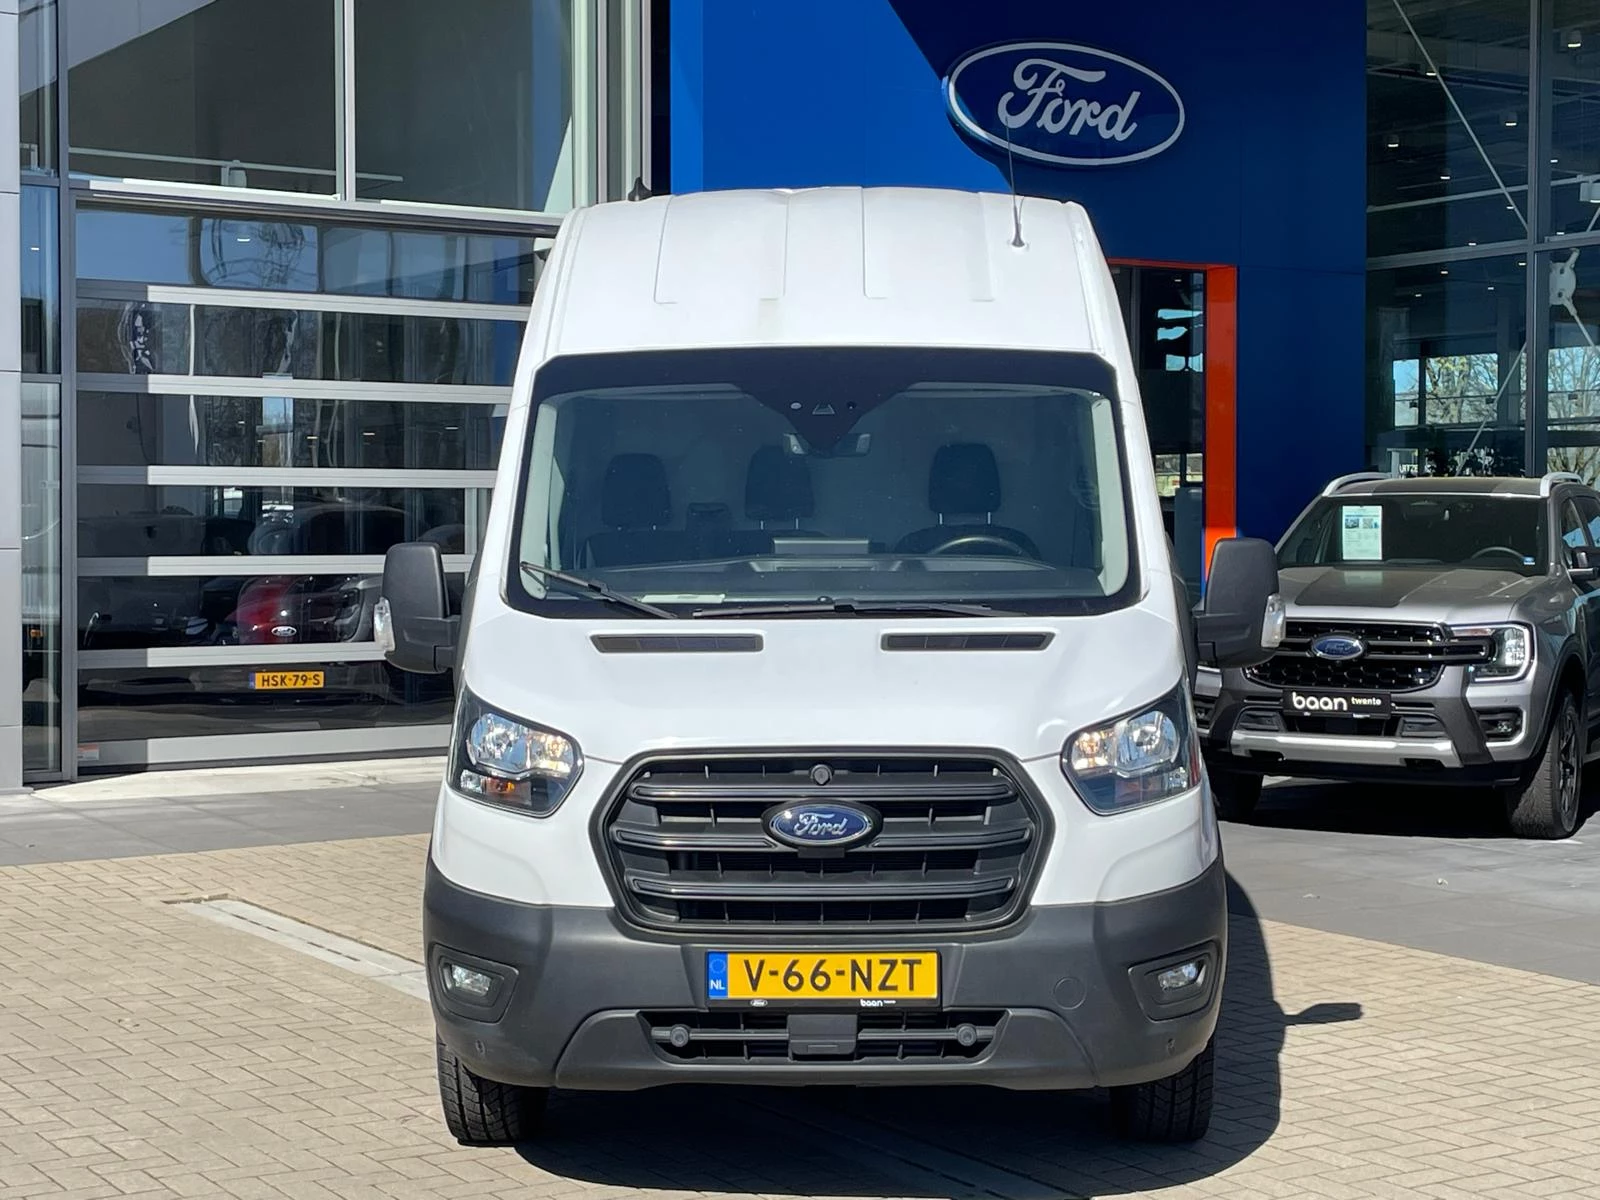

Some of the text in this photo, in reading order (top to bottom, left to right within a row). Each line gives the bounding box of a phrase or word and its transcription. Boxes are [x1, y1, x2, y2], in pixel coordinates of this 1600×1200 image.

[997, 58, 1141, 141] Ford
[261, 674, 321, 688] HSK-79-S
[1292, 691, 1348, 711] baan
[793, 812, 848, 836] Ford
[710, 979, 726, 990] NL
[743, 959, 922, 992] V-66-NZT
[860, 999, 883, 1007] baan
